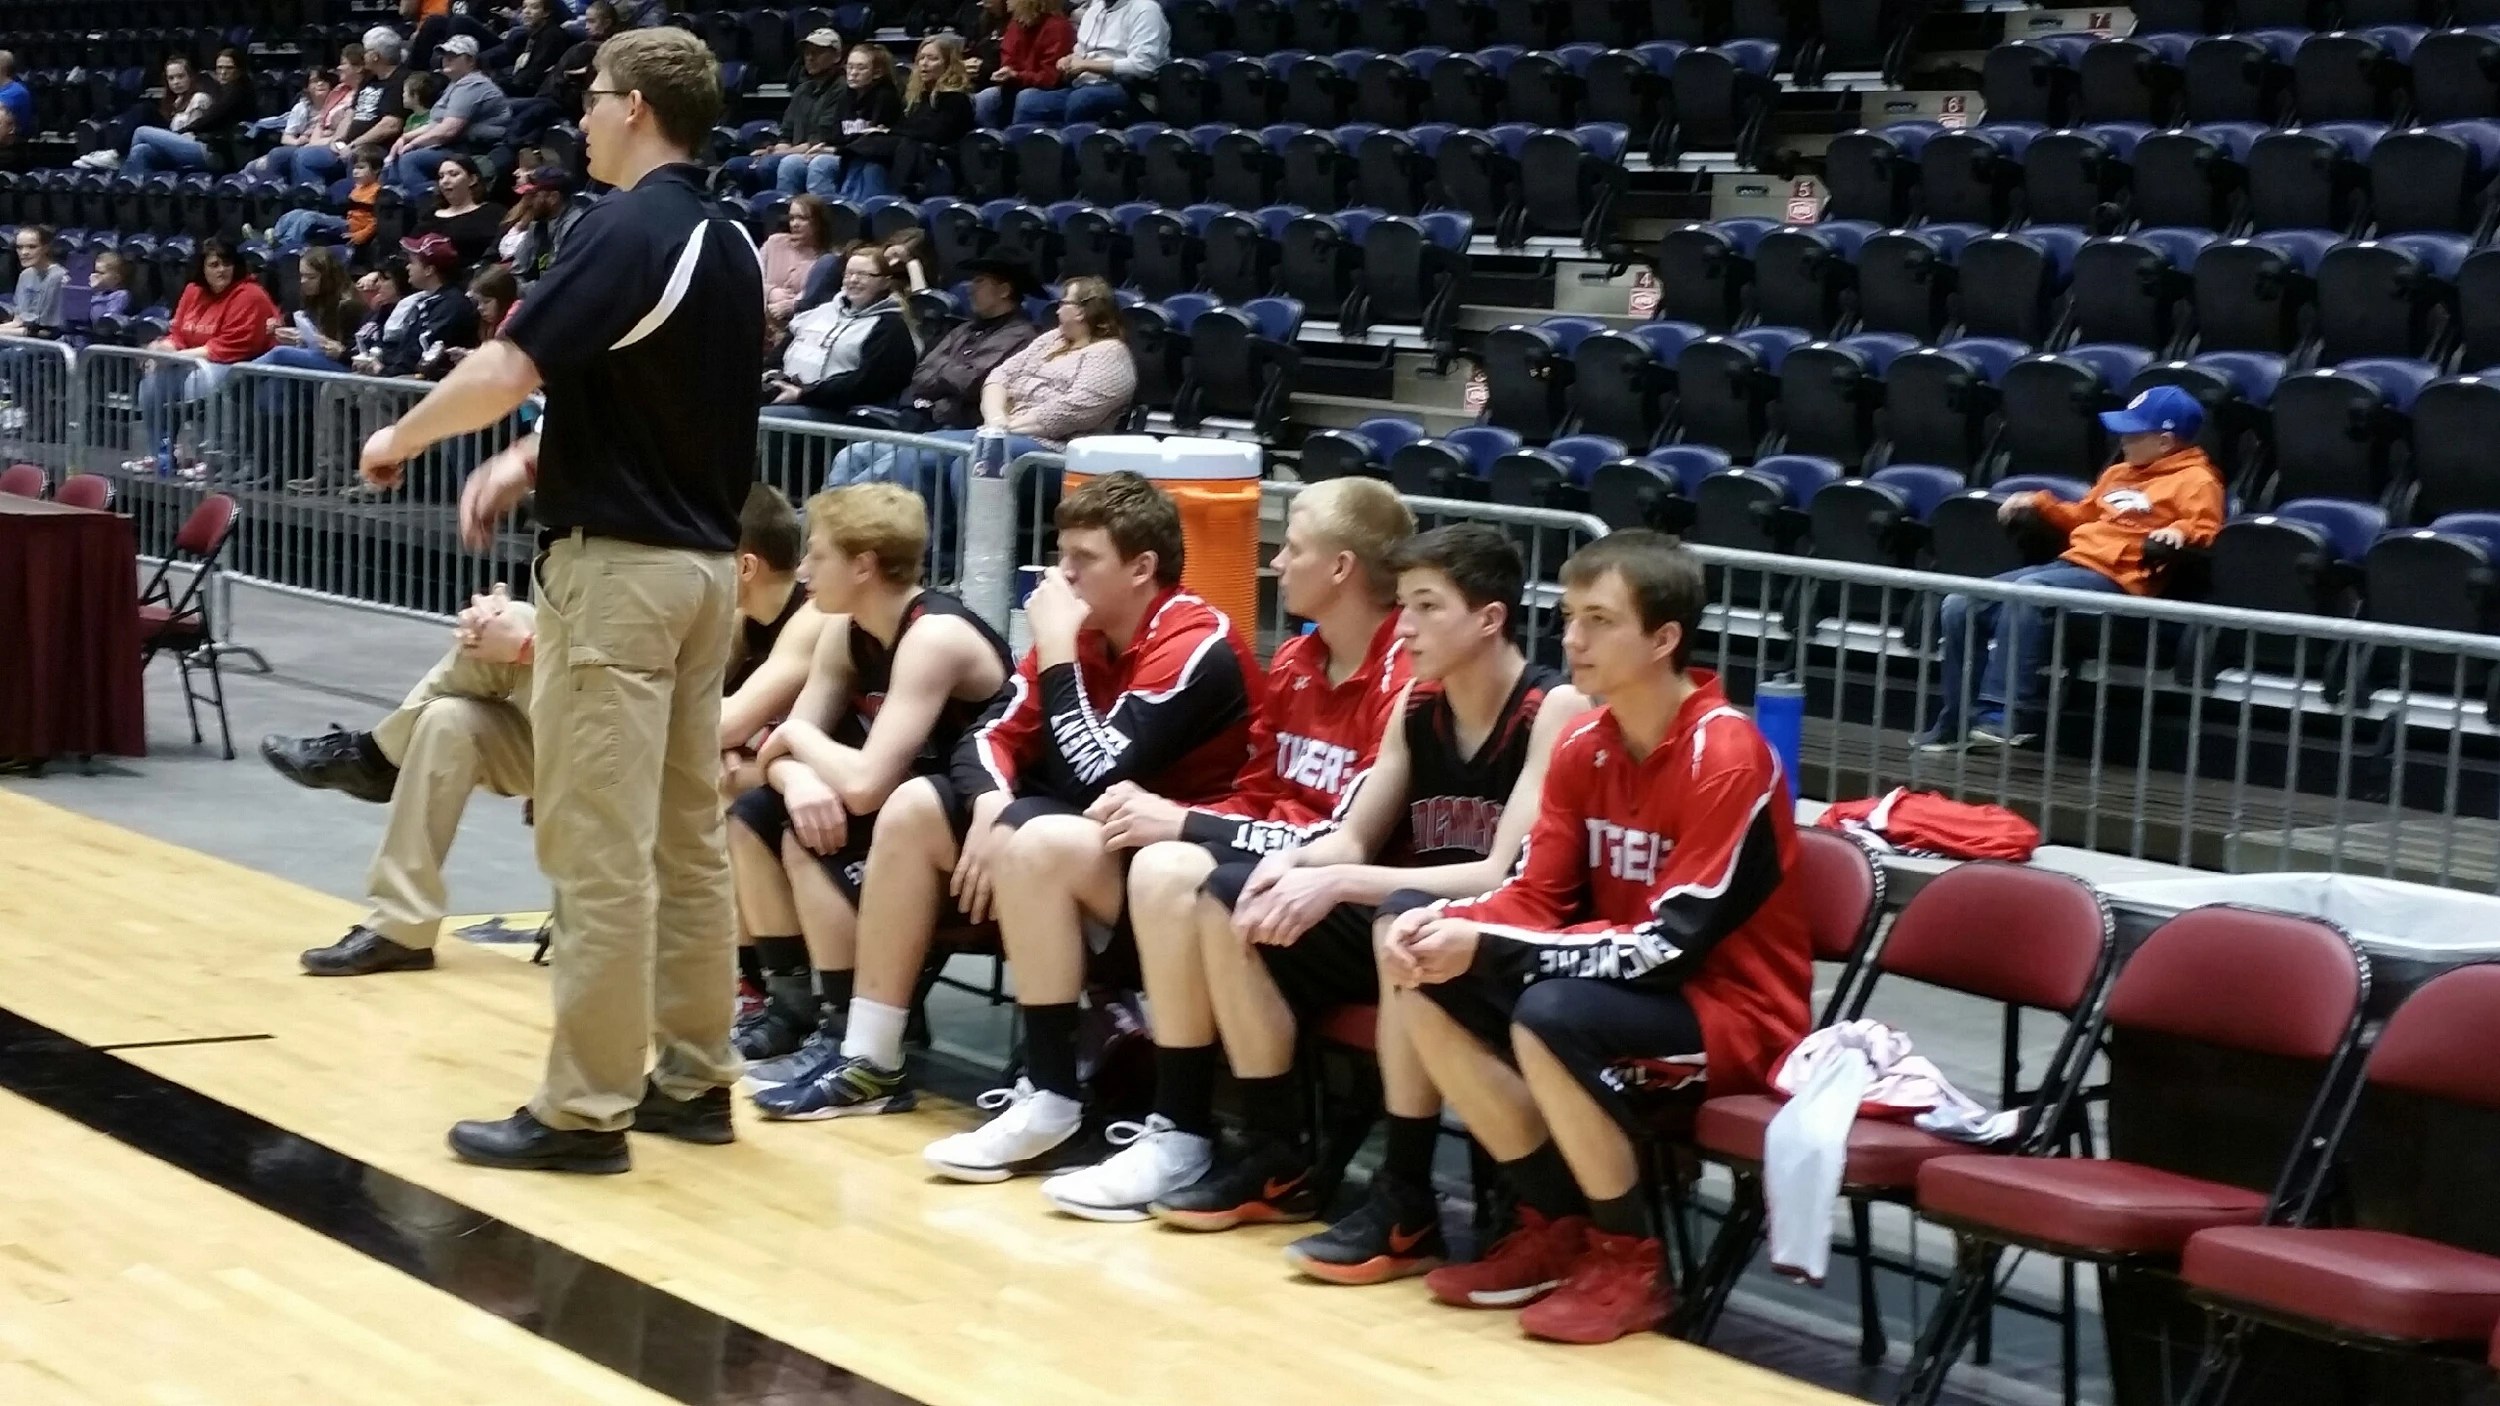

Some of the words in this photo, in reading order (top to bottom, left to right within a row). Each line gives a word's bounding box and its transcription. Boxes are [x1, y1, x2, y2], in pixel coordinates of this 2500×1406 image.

[2096, 13, 2105, 28] 7
[1948, 97, 1959, 113] 6
[1798, 181, 1811, 197] 5
[1639, 272, 1651, 288] 4
